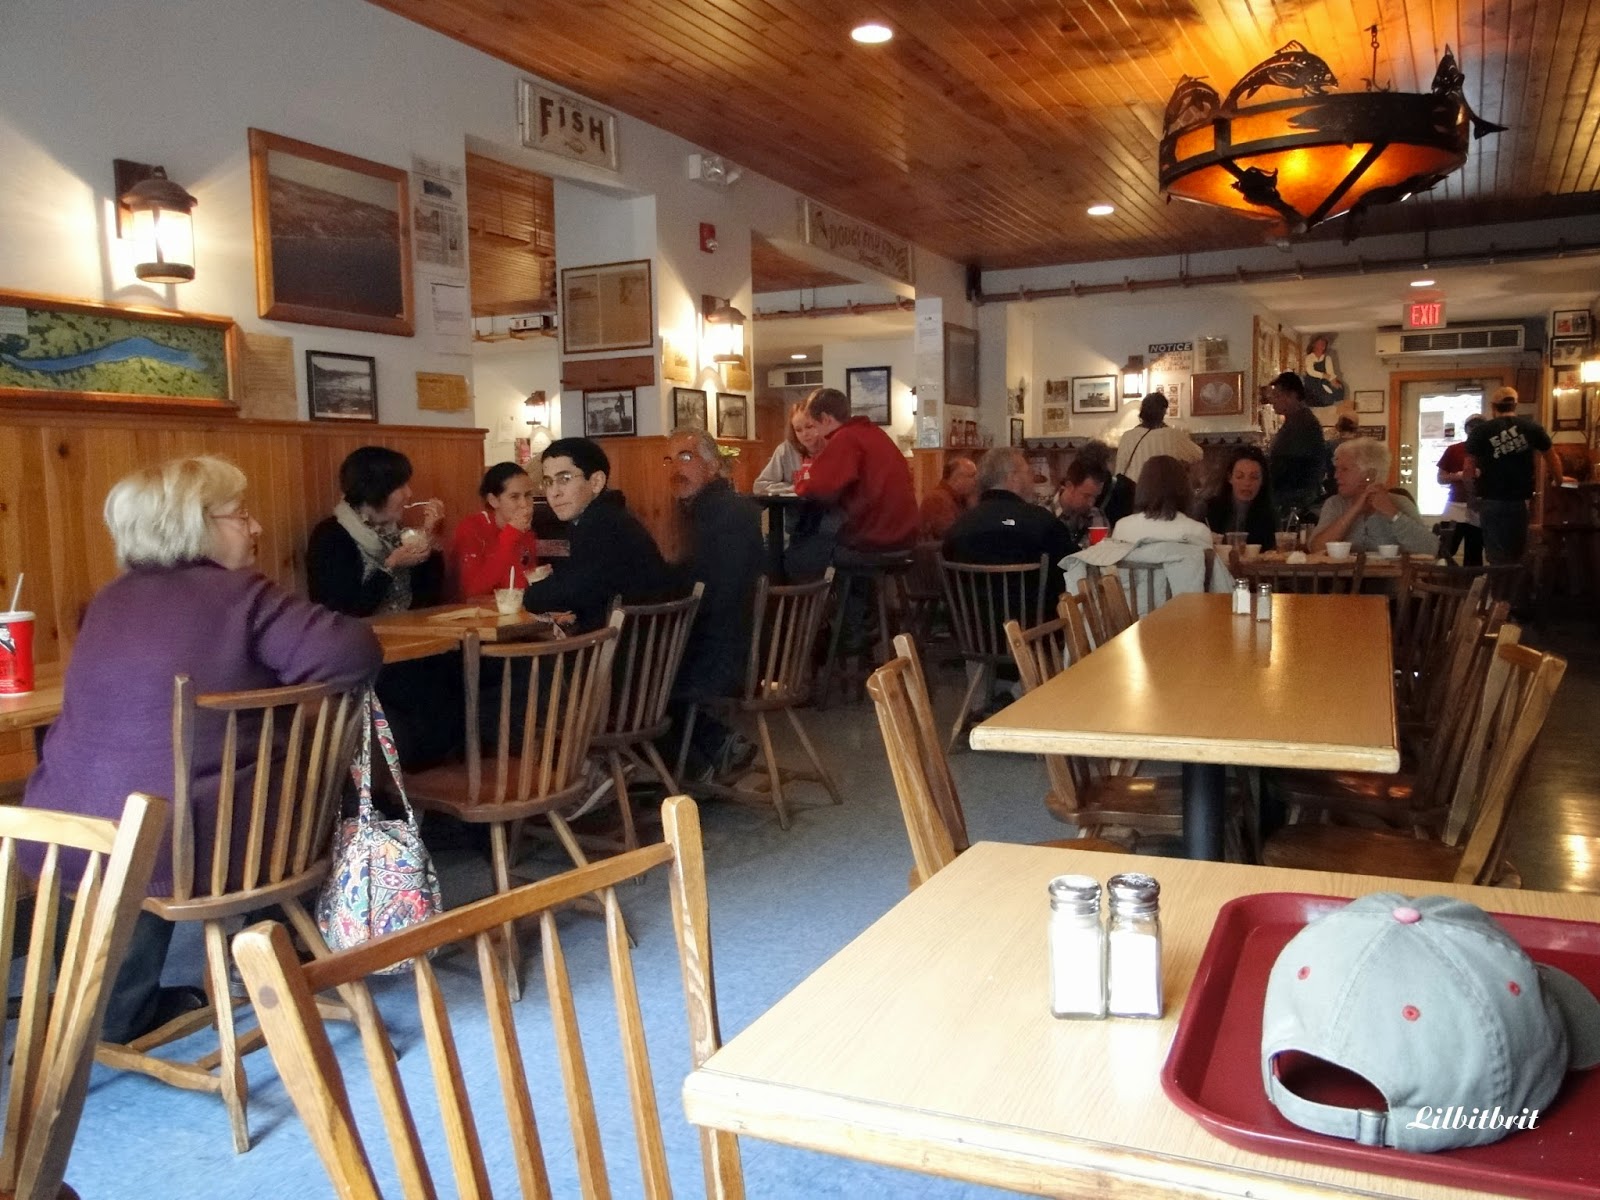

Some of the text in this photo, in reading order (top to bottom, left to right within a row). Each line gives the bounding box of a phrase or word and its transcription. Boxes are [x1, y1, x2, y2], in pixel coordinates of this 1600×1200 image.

[539, 96, 606, 154] FISH
[1411, 303, 1441, 327] EXIT
[1150, 343, 1191, 353] NOTICE
[1489, 425, 1518, 448] EAT
[1493, 433, 1527, 459] FISH
